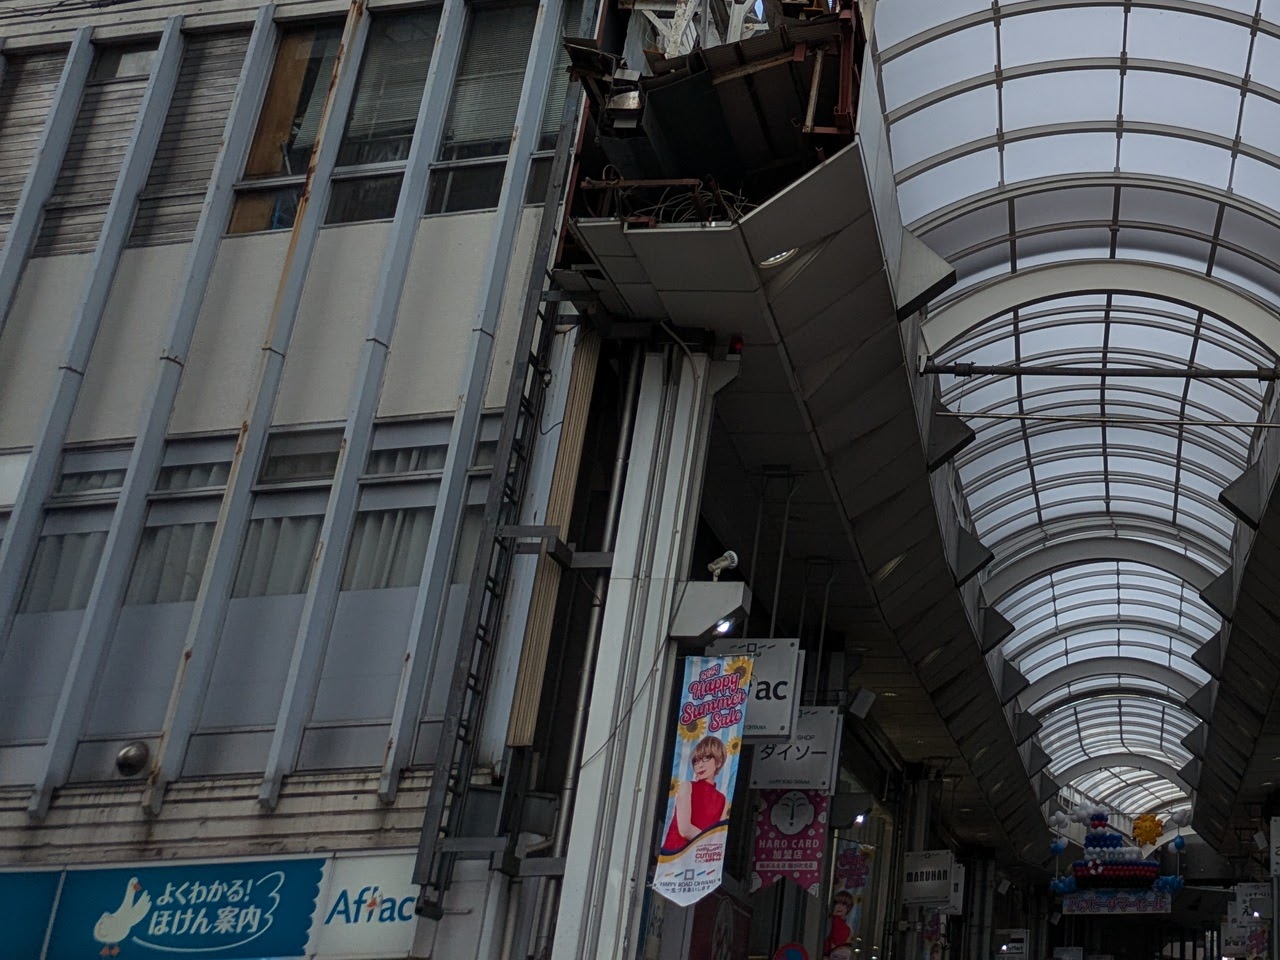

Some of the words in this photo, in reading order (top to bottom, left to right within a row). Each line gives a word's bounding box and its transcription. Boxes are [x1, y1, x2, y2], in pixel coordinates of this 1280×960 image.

[688, 672, 741, 700] Happy
[680, 689, 748, 725] Summer
[708, 708, 743, 733] Sale
[760, 744, 827, 760] ダイソー
[759, 839, 789, 848] HARO
[791, 839, 820, 848] CARD
[772, 850, 803, 860] 加盟店
[906, 869, 948, 883] MARUHAN
[156, 878, 254, 907] よくわかる!
[324, 885, 416, 924] Aflac
[148, 907, 262, 936] ほけん案内
